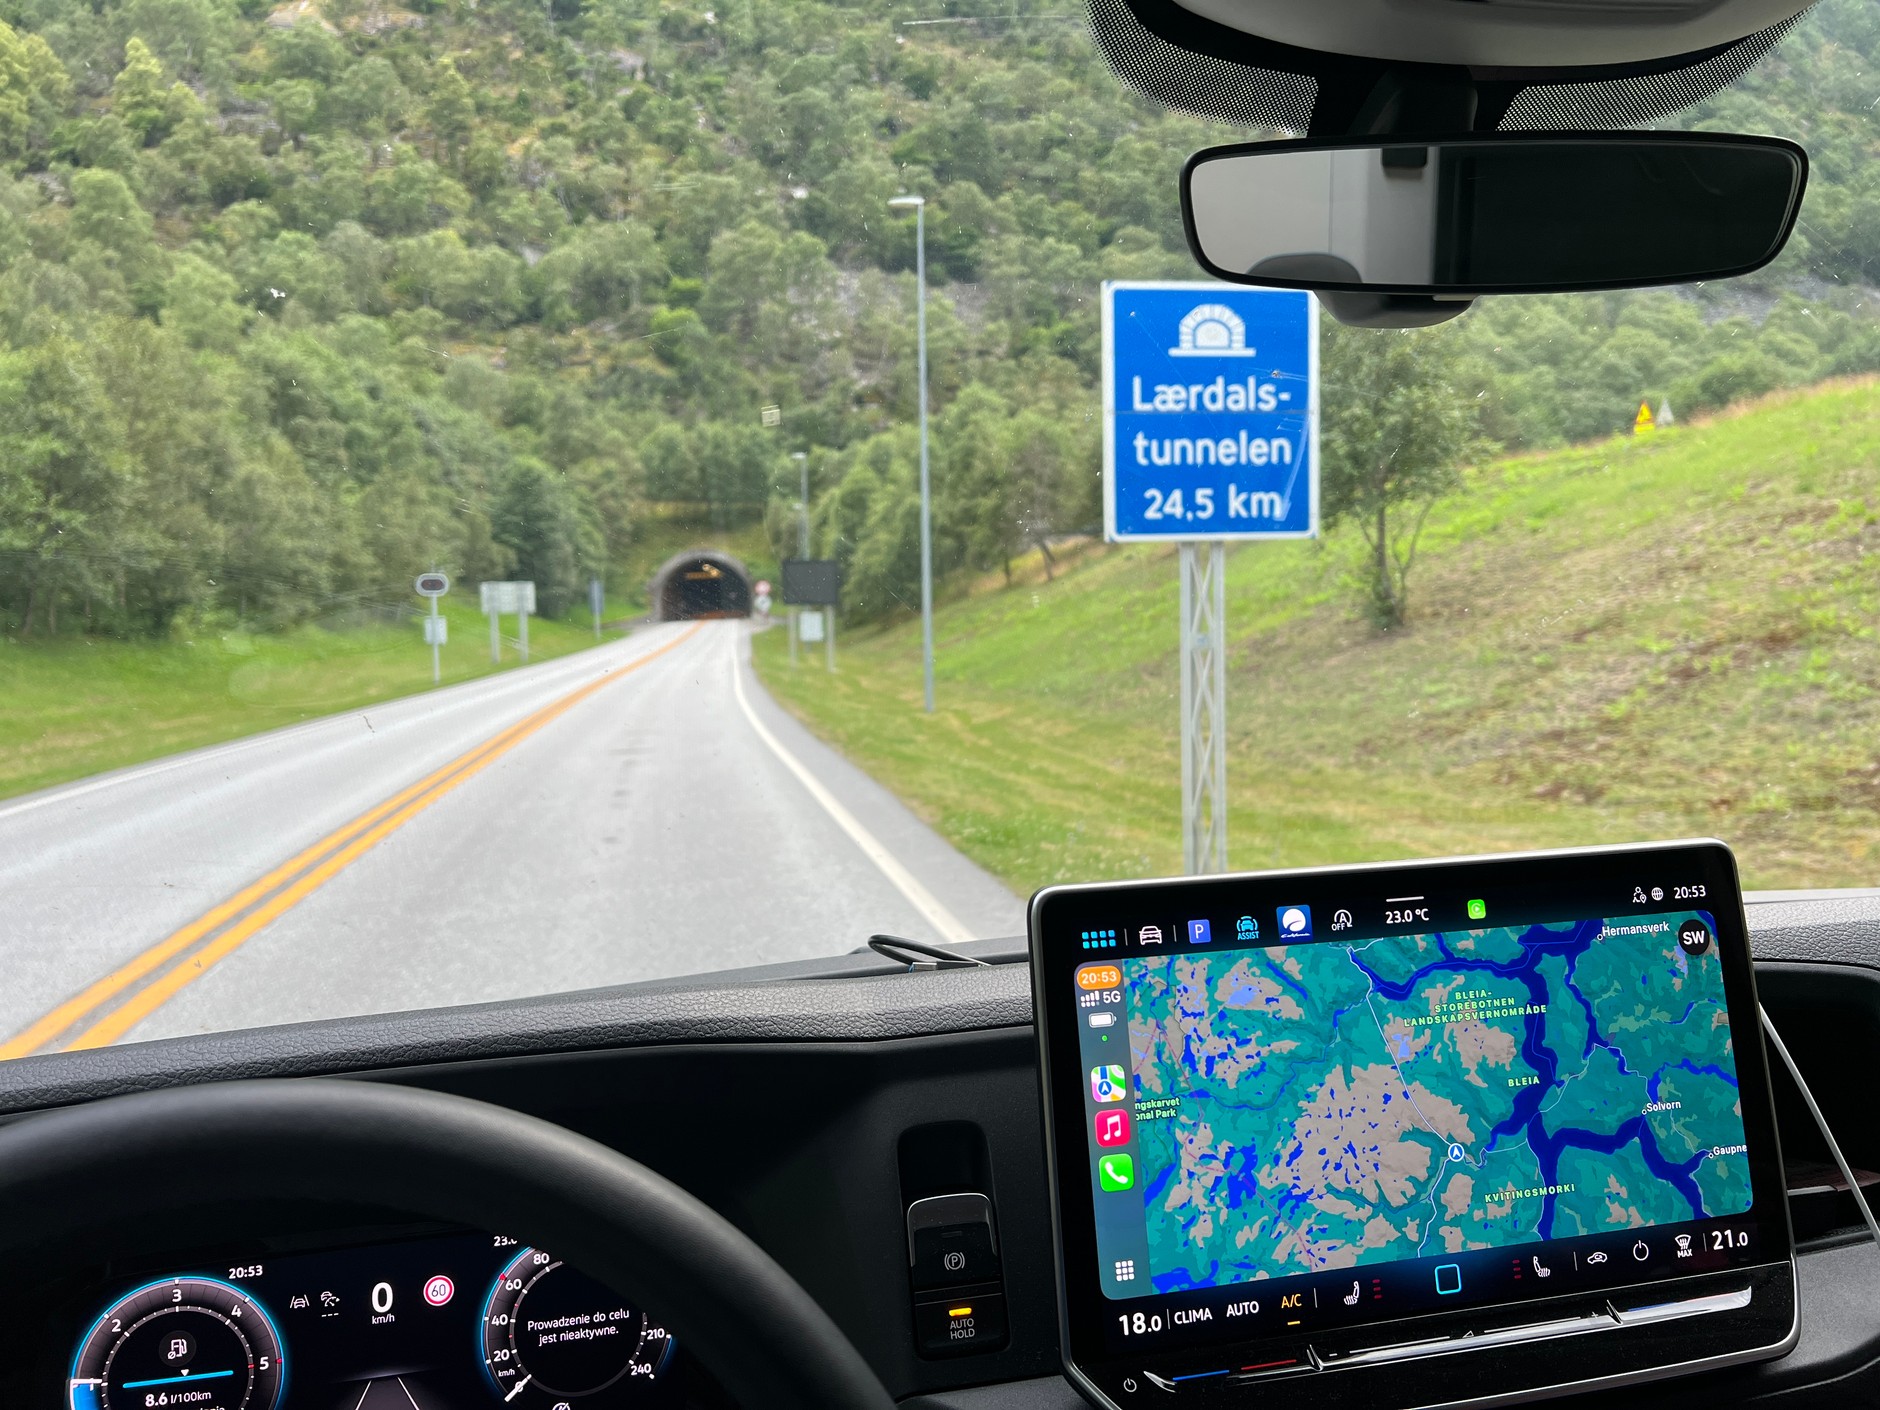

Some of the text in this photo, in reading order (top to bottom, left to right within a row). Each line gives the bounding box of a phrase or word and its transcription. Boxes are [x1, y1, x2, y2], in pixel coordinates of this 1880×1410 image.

[1133, 375, 1291, 412] Lærdals-
[1133, 429, 1292, 465] tunnelen
[1144, 483, 1283, 522] 24,5 km
[1673, 885, 1707, 899] 20:53
[1385, 908, 1430, 924] 23.0 °C
[1331, 923, 1346, 931] OFF
[1602, 921, 1670, 937] Hermansverk
[1237, 930, 1259, 940] ASSIST
[1683, 930, 1705, 945] SW
[1081, 971, 1117, 984] 20:53
[1103, 990, 1121, 1003] 5G
[1455, 990, 1492, 1000] BLEIA-
[1434, 997, 1515, 1013] STOREBOTNEN
[1404, 1004, 1547, 1027] LANDSKAPSVERNOMRÅDE
[1508, 1076, 1540, 1087] BLEIA
[1646, 1101, 1681, 1112] Solvorn
[1156, 1108, 1176, 1119] Park
[1713, 1144, 1747, 1156] Gaupne
[1485, 1183, 1575, 1203] KVITINGSMORKI
[1712, 1229, 1749, 1250] 21.0
[533, 1253, 550, 1265] 80
[1677, 1249, 1693, 1258] MAX
[228, 1265, 263, 1280] 20:53
[431, 1284, 447, 1297] 60
[505, 1278, 522, 1291] 60
[172, 1289, 182, 1302] 3
[372, 1282, 393, 1313] 0
[1281, 1294, 1302, 1309] A/C
[231, 1305, 242, 1318] 4
[1226, 1301, 1260, 1318] AUTO
[371, 1313, 395, 1325] km/h
[491, 1313, 508, 1326] 40
[527, 1308, 630, 1331] Prowadzenie do celu
[1174, 1308, 1213, 1325] CLIMA
[111, 1319, 122, 1332] 2
[950, 1318, 974, 1330] AUTO
[1118, 1312, 1162, 1336] 18.0
[538, 1326, 619, 1347] jest nieaktywne.
[647, 1328, 665, 1340] 210
[950, 1328, 975, 1339] HOLD
[493, 1349, 510, 1362] 20
[260, 1356, 269, 1370] 5
[631, 1363, 652, 1376] 240
[498, 1368, 516, 1377] km/h
[145, 1393, 168, 1407] 8.6
